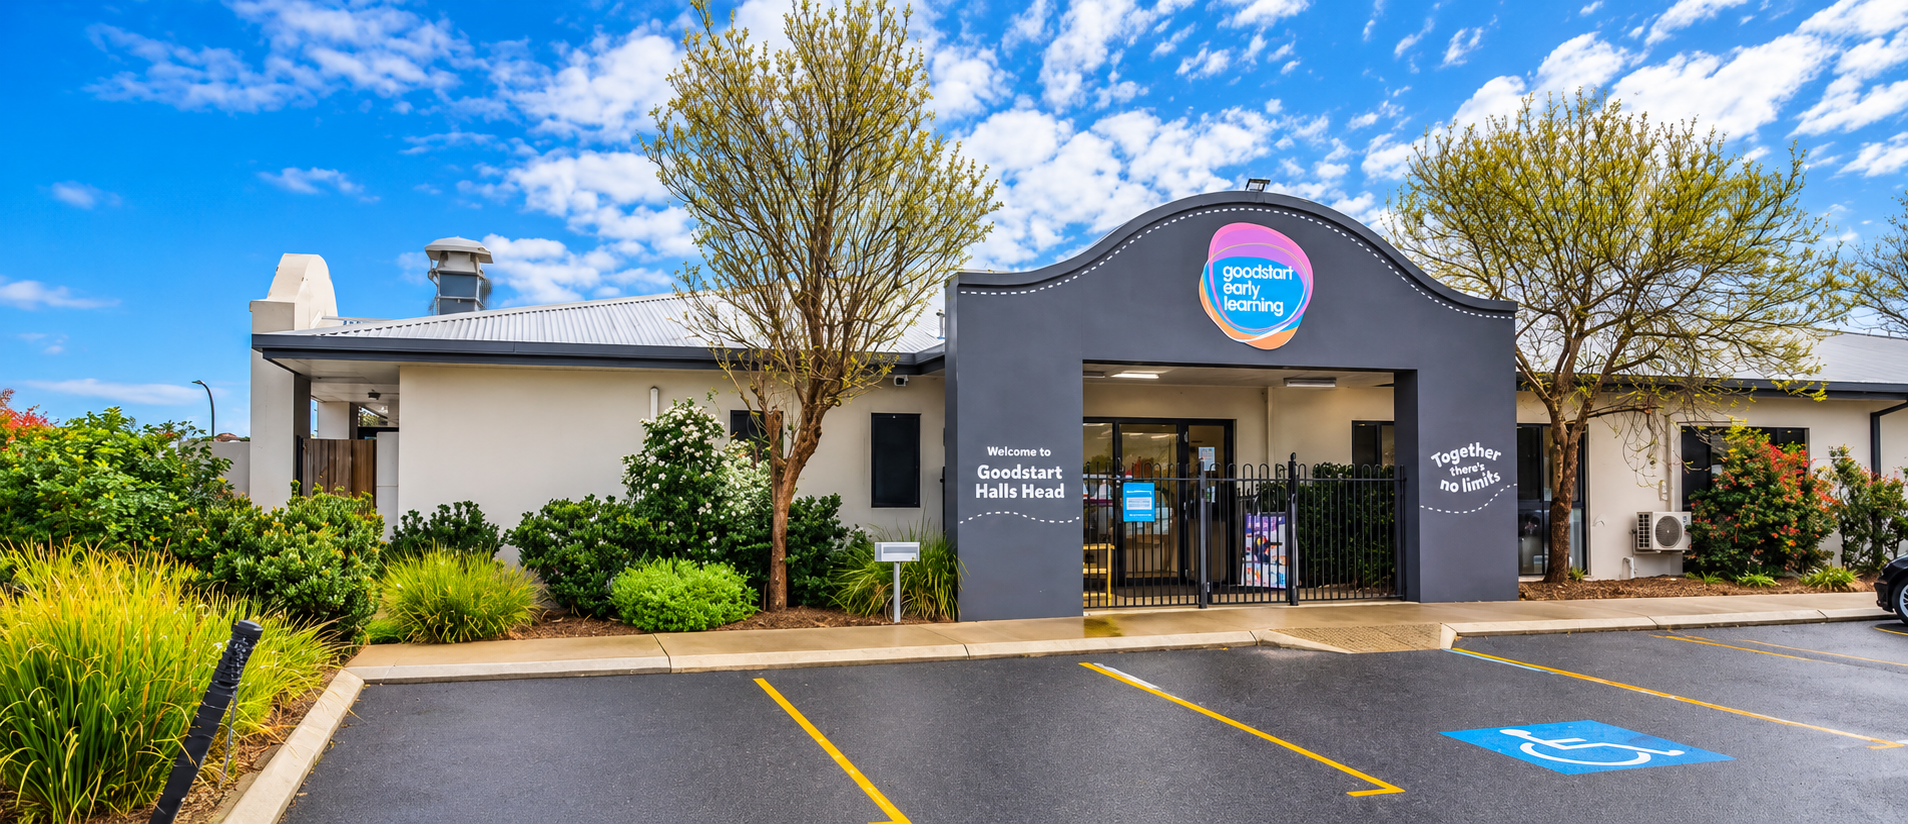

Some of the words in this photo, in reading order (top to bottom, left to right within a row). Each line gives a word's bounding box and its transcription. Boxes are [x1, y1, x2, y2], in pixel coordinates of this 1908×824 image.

[1223, 264, 1293, 282] goodstart
[1223, 280, 1260, 300] early
[1224, 295, 1284, 316] learning
[987, 446, 1037, 457] Welcome
[1039, 447, 1051, 457] to
[1430, 442, 1502, 468] Together
[977, 463, 1062, 480] Goodstart
[1449, 462, 1485, 476] there's
[1440, 479, 1459, 493] no
[1462, 470, 1501, 493] limits
[975, 483, 1018, 499] Halls
[1022, 483, 1065, 499] Head
